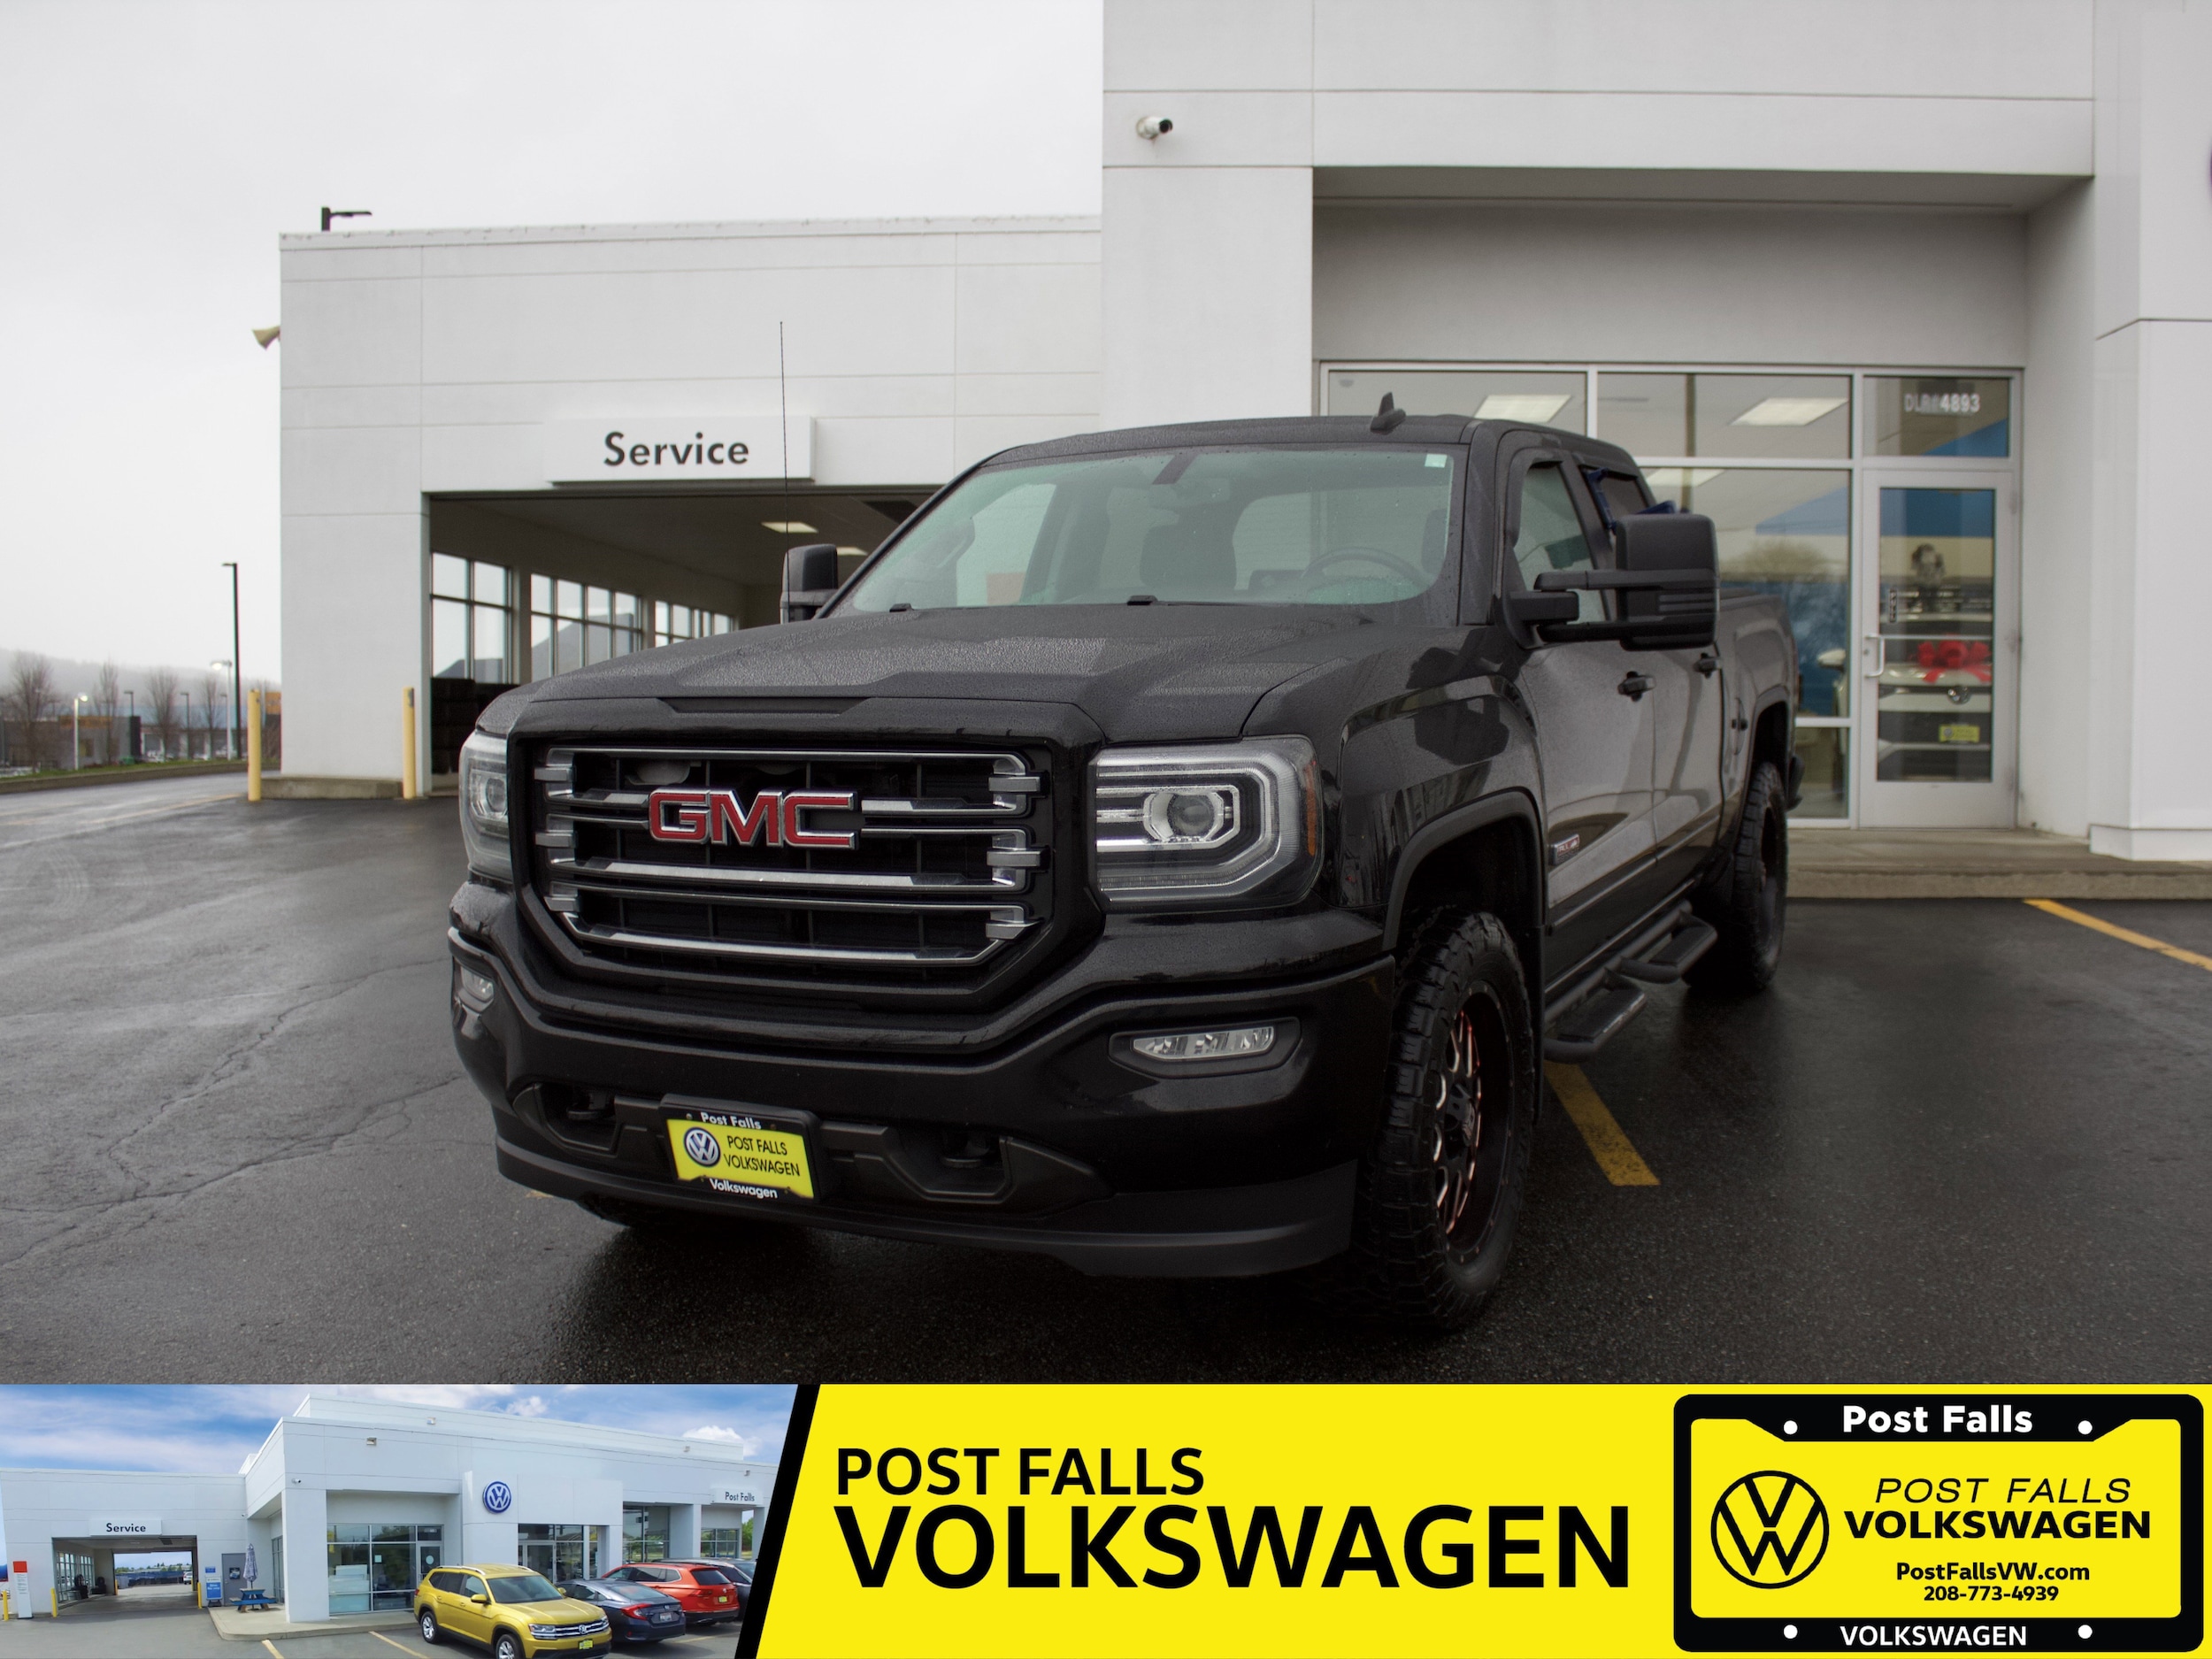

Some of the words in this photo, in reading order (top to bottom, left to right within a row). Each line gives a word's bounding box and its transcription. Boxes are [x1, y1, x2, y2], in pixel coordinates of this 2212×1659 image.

[603, 431, 749, 466] Service
[649, 787, 856, 850] GMC
[701, 1111, 727, 1126] Post
[730, 1115, 762, 1130] Falls
[727, 1135, 754, 1151] POST
[757, 1140, 787, 1155] FALLS
[724, 1155, 800, 1176] VOLKSWAGEN
[710, 1179, 778, 1198] Volkswagen
